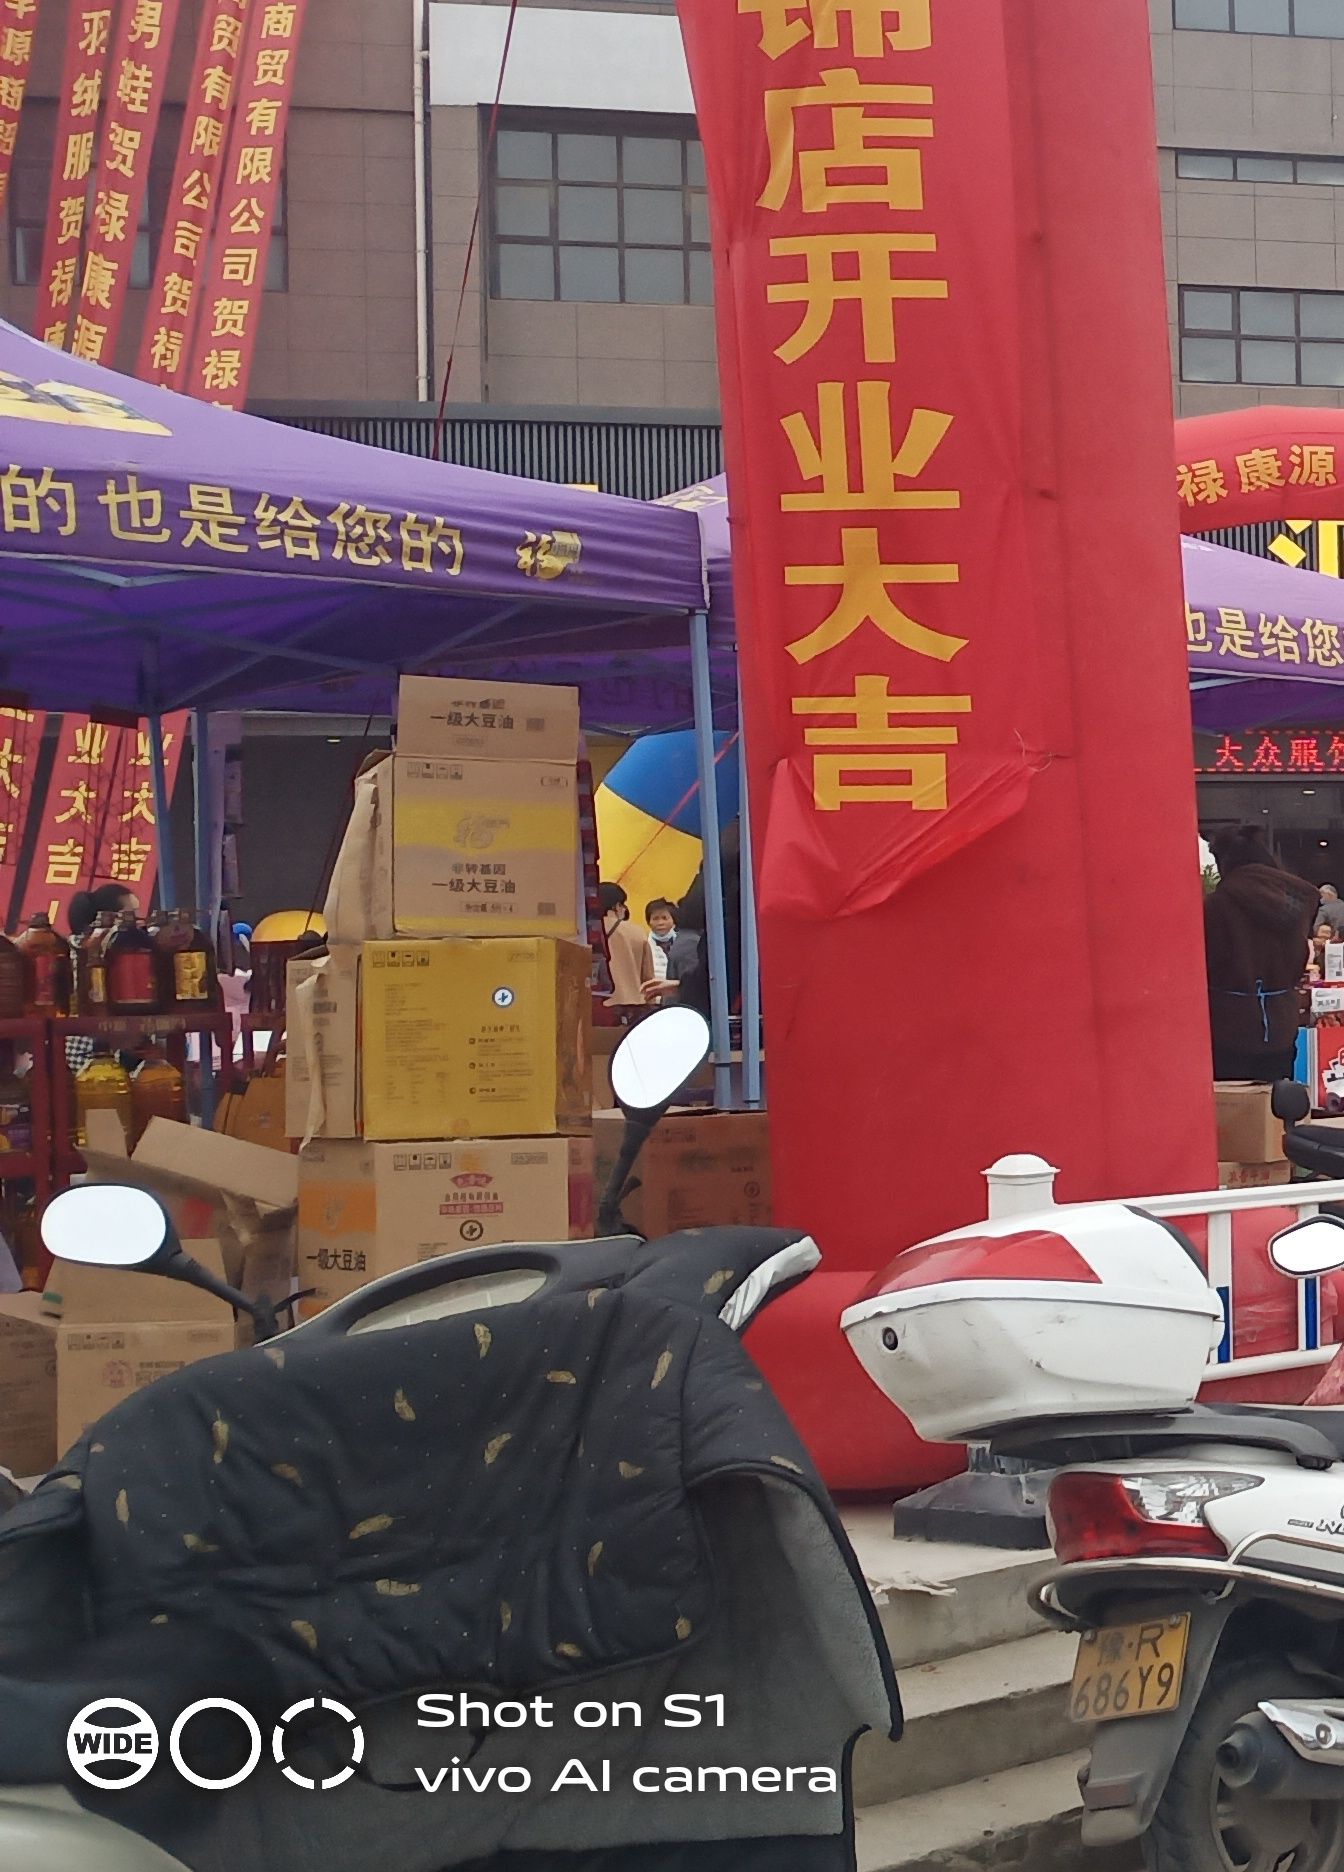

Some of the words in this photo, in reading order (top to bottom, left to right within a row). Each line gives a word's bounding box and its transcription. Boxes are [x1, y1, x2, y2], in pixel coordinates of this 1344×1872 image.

[152, 0, 246, 392] 贸有限公司贺禄
[203, 2, 296, 410] 商贸有限公司贺禄
[430, 713, 514, 730] 一级大豆油
[431, 878, 516, 894] 一级大豆油
